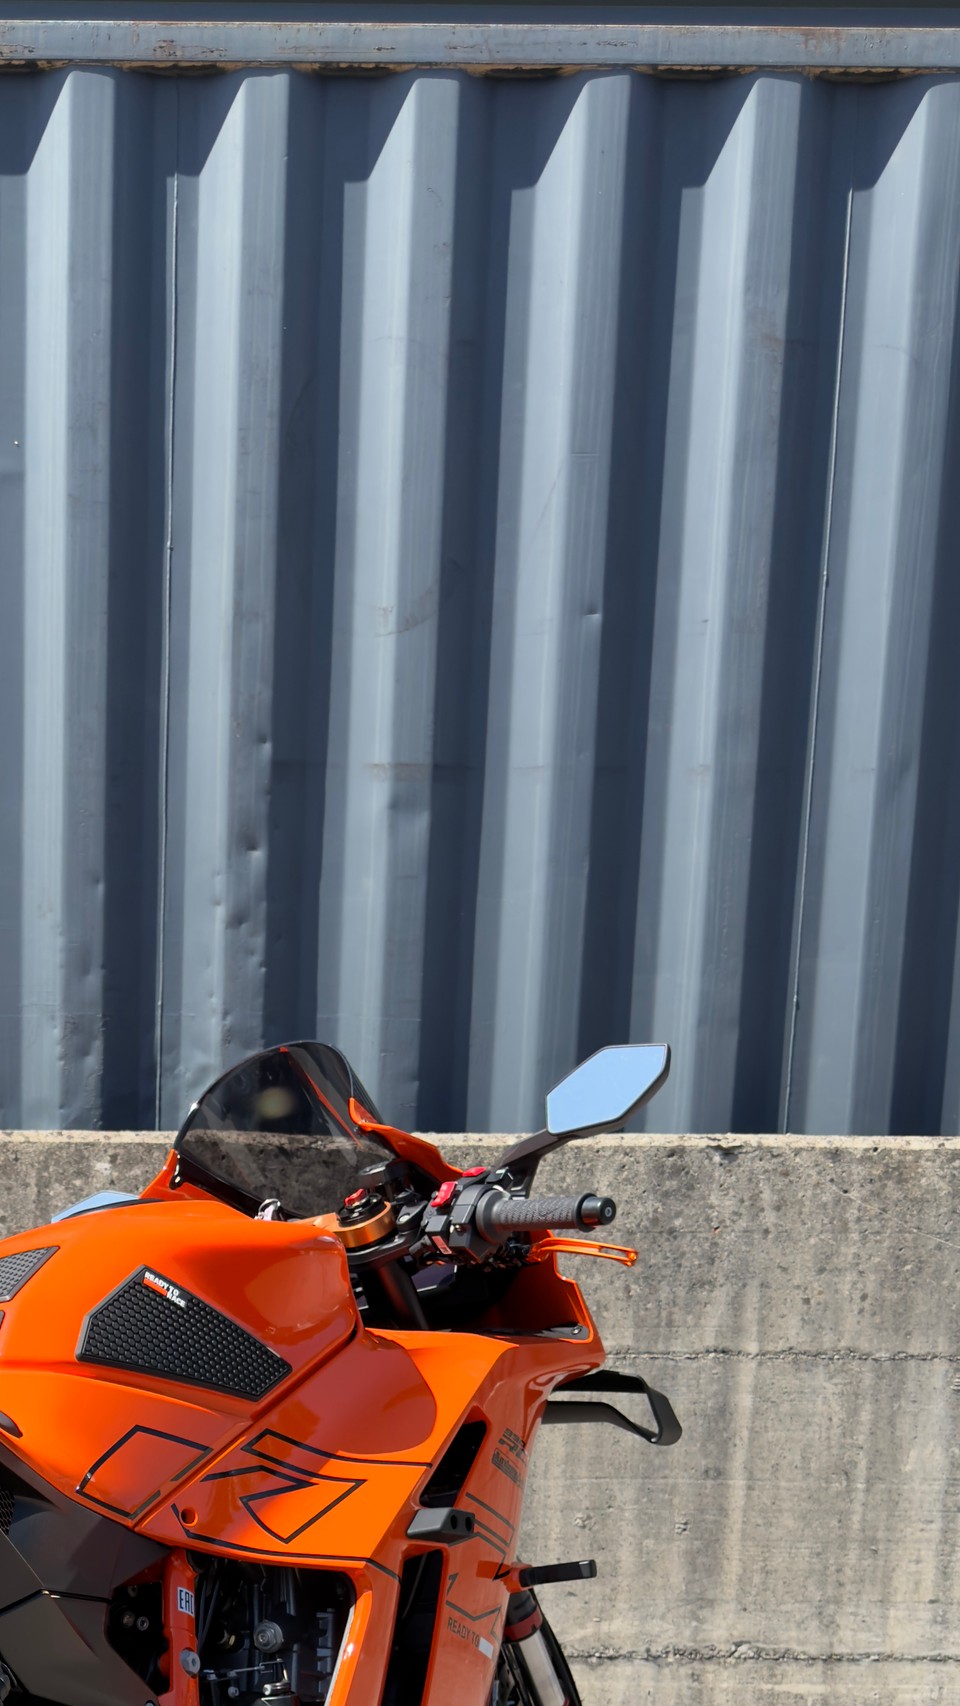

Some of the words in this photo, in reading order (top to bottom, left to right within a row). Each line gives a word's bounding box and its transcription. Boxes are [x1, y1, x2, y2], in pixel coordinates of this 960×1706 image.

[144, 1271, 169, 1290] READY
[168, 1285, 180, 1297] TO
[166, 1291, 186, 1308] RACE
[447, 1616, 471, 1642] READY
[471, 1630, 481, 1649] TO
